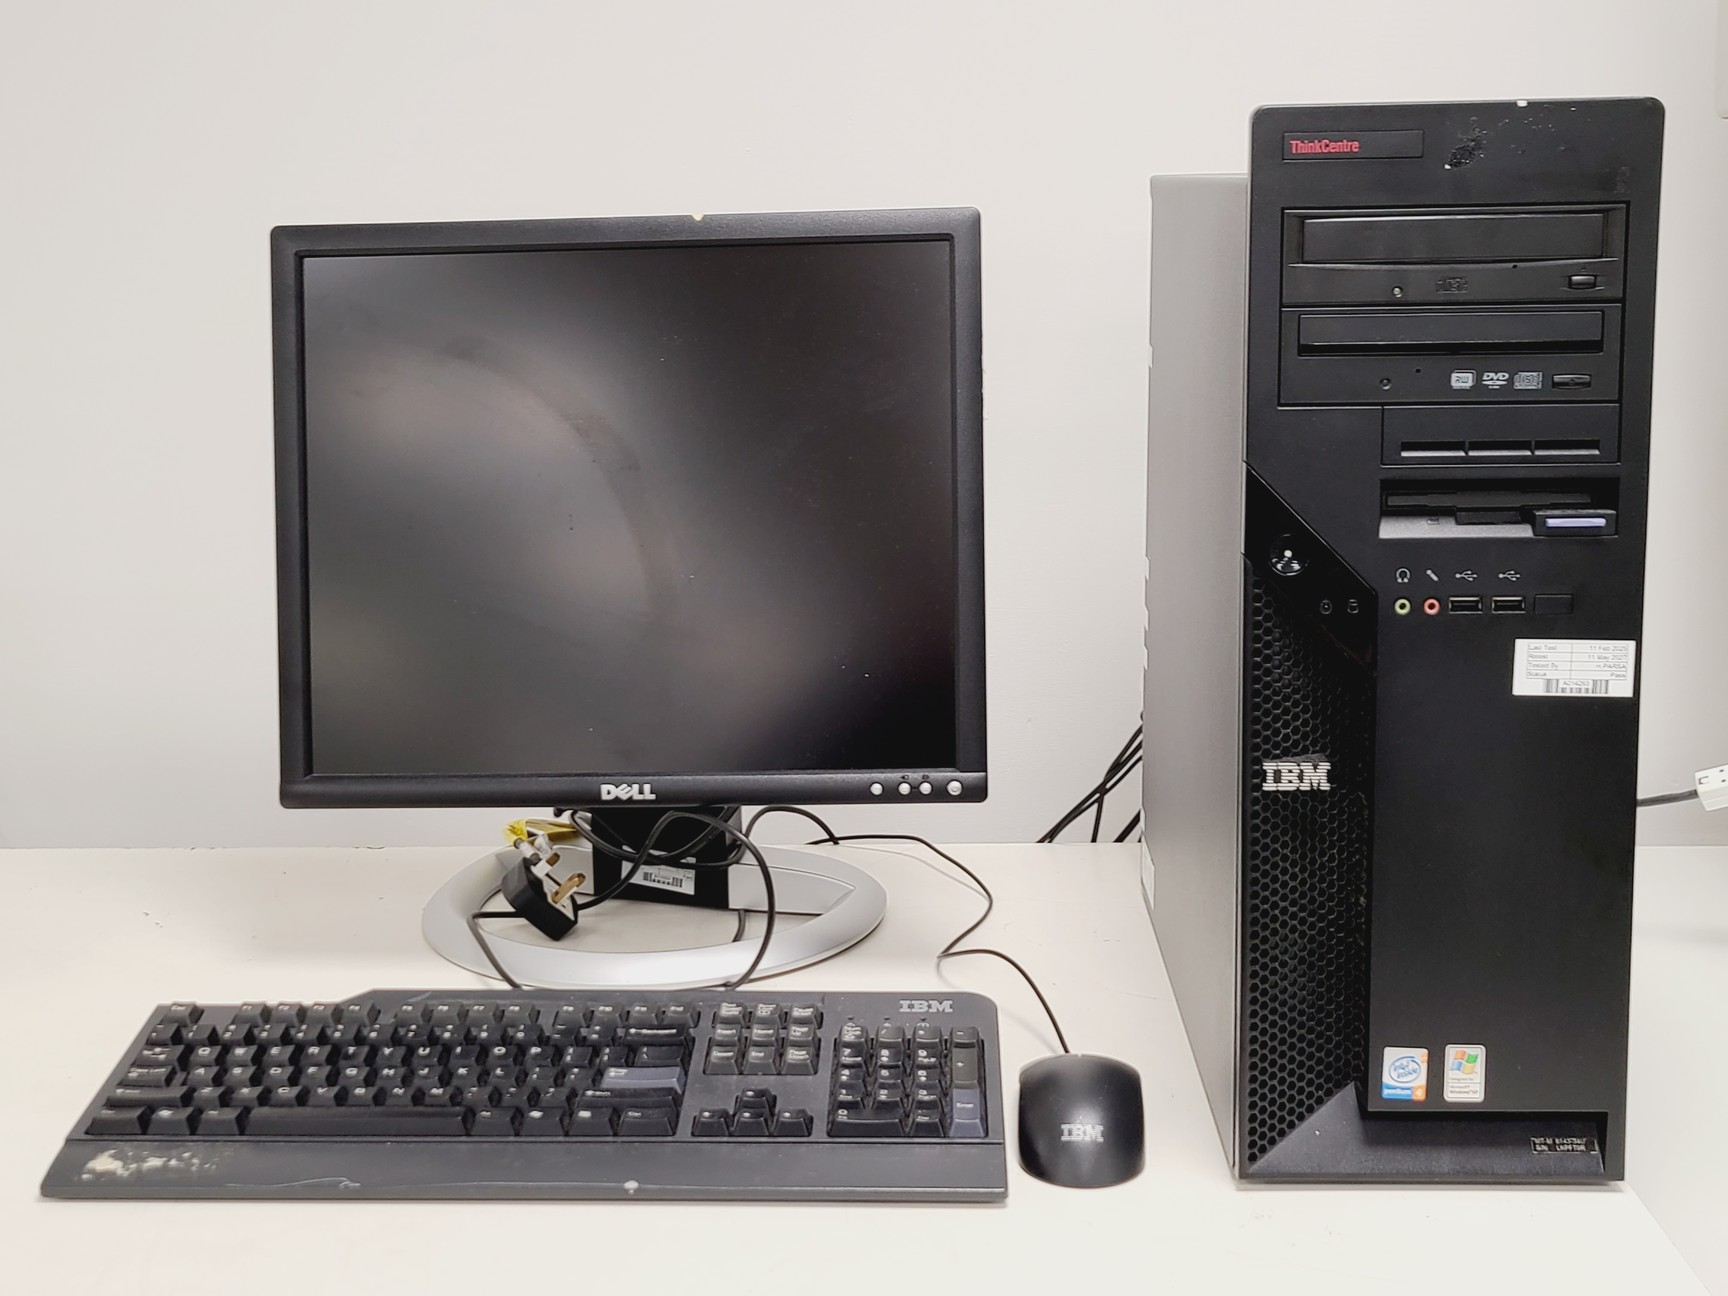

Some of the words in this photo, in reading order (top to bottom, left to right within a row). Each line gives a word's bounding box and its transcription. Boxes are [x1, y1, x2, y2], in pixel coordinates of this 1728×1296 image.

[1289, 139, 1359, 154] ThinkCentre
[1482, 372, 1509, 381] DVD
[1262, 762, 1332, 791] IBM
[600, 783, 656, 800] DELL
[900, 1000, 953, 1012] IBM
[270, 1046, 282, 1055] E
[347, 1046, 357, 1055] T
[383, 1046, 394, 1055] Y
[418, 1046, 431, 1056] U
[493, 1046, 506, 1056] O
[530, 1046, 542, 1055] P
[194, 1066, 206, 1075] A
[232, 1066, 243, 1075] S
[307, 1066, 319, 1075] F
[345, 1067, 358, 1076] G
[382, 1067, 395, 1076] H
[418, 1067, 430, 1076] J
[457, 1067, 469, 1076] K
[495, 1067, 505, 1076] L
[277, 1086, 290, 1094] C
[317, 1086, 328, 1094] V
[1060, 1123, 1104, 1142] IBM
